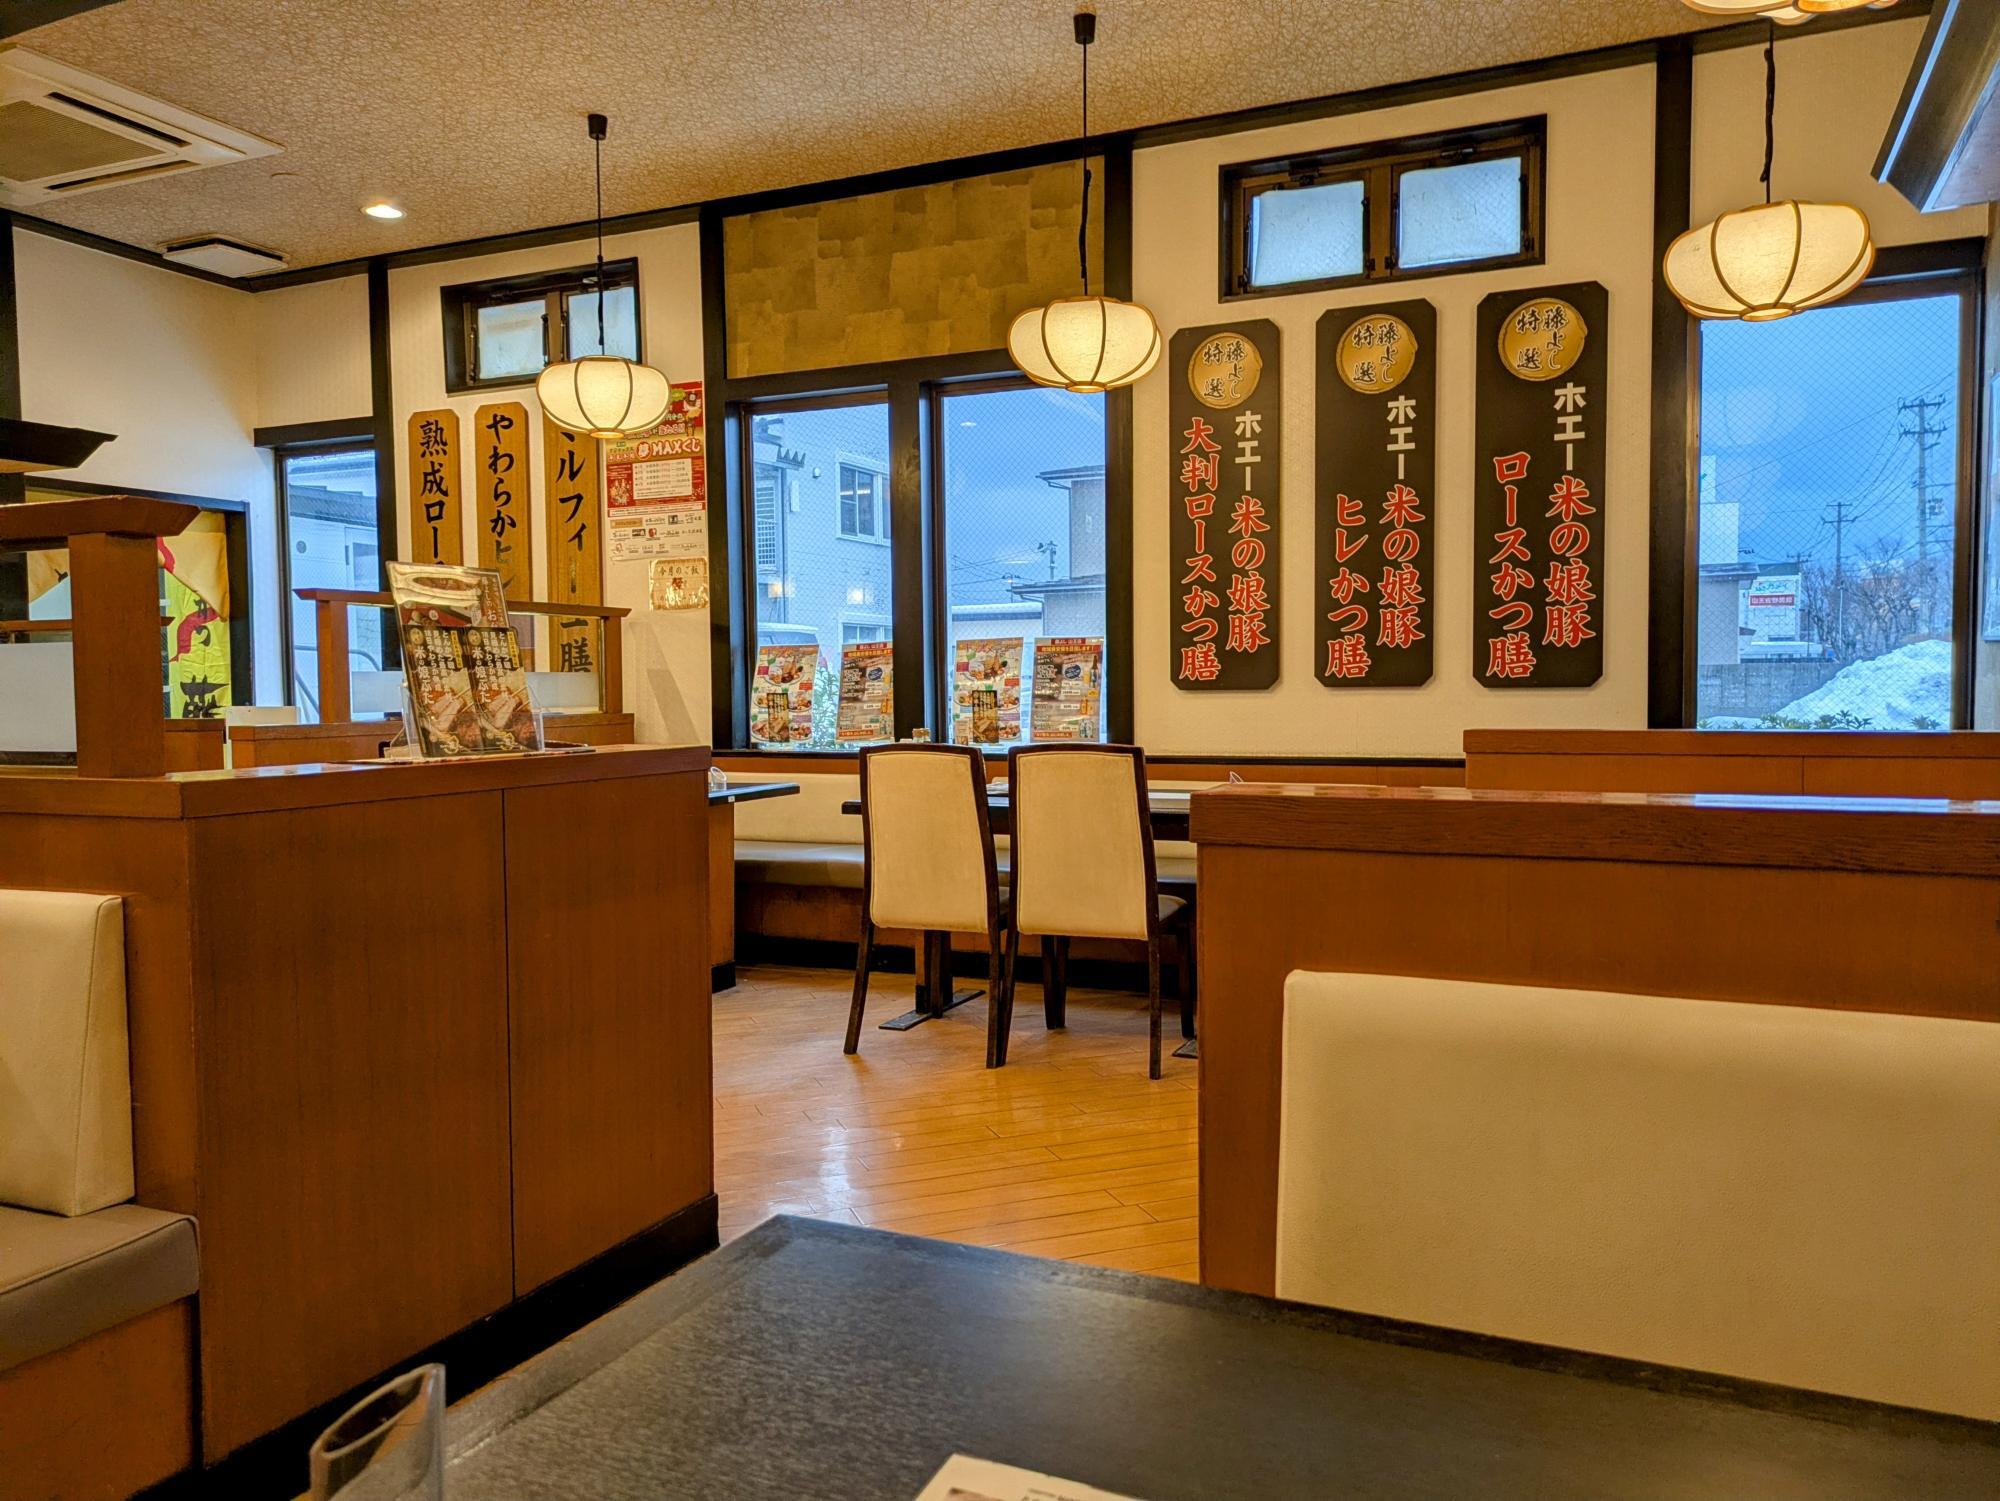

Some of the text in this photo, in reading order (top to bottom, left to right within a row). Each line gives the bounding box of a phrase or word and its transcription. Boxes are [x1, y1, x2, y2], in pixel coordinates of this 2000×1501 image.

[419, 420, 449, 565] 熟成ロー
[1179, 416, 1222, 681] 大判ロースかつ膳
[1324, 493, 1372, 679] ヒレかつ膳
[1486, 451, 1537, 679] ロースかつ膳
